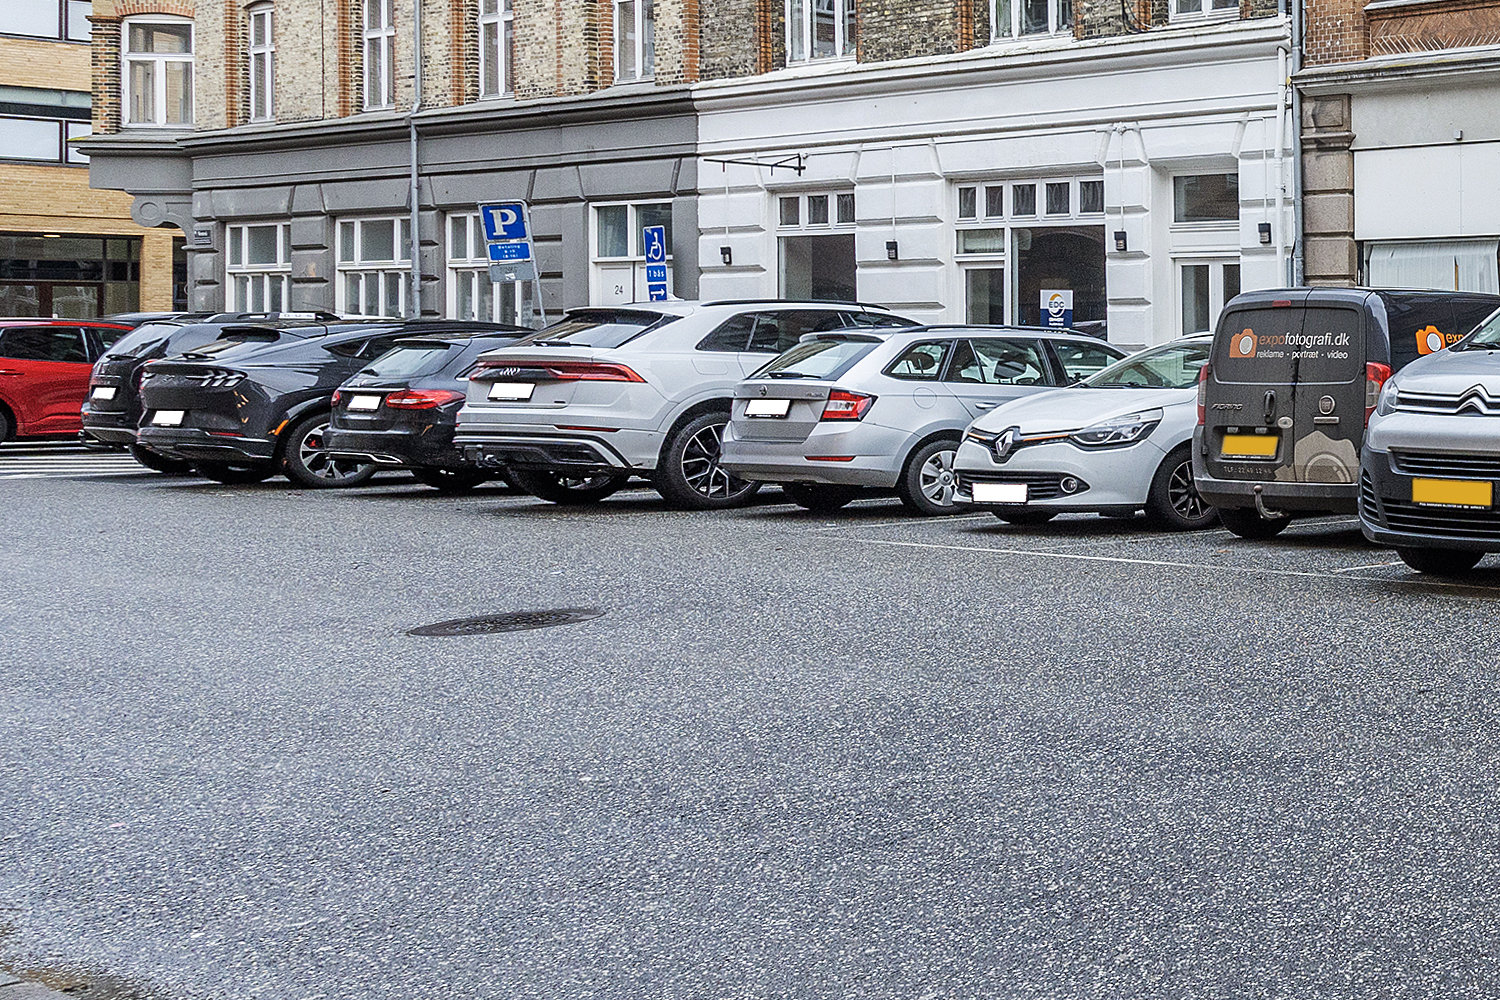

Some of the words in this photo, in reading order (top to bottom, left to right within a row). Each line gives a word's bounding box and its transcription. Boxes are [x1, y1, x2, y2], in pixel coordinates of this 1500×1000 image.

[489, 208, 518, 236] P
[614, 284, 624, 295] 24
[1048, 301, 1065, 309] EDC
[1259, 332, 1350, 349] expofotografi.dk
[1256, 350, 1285, 359] reklame
[1291, 350, 1319, 360] portræt
[1326, 350, 1349, 359] video
